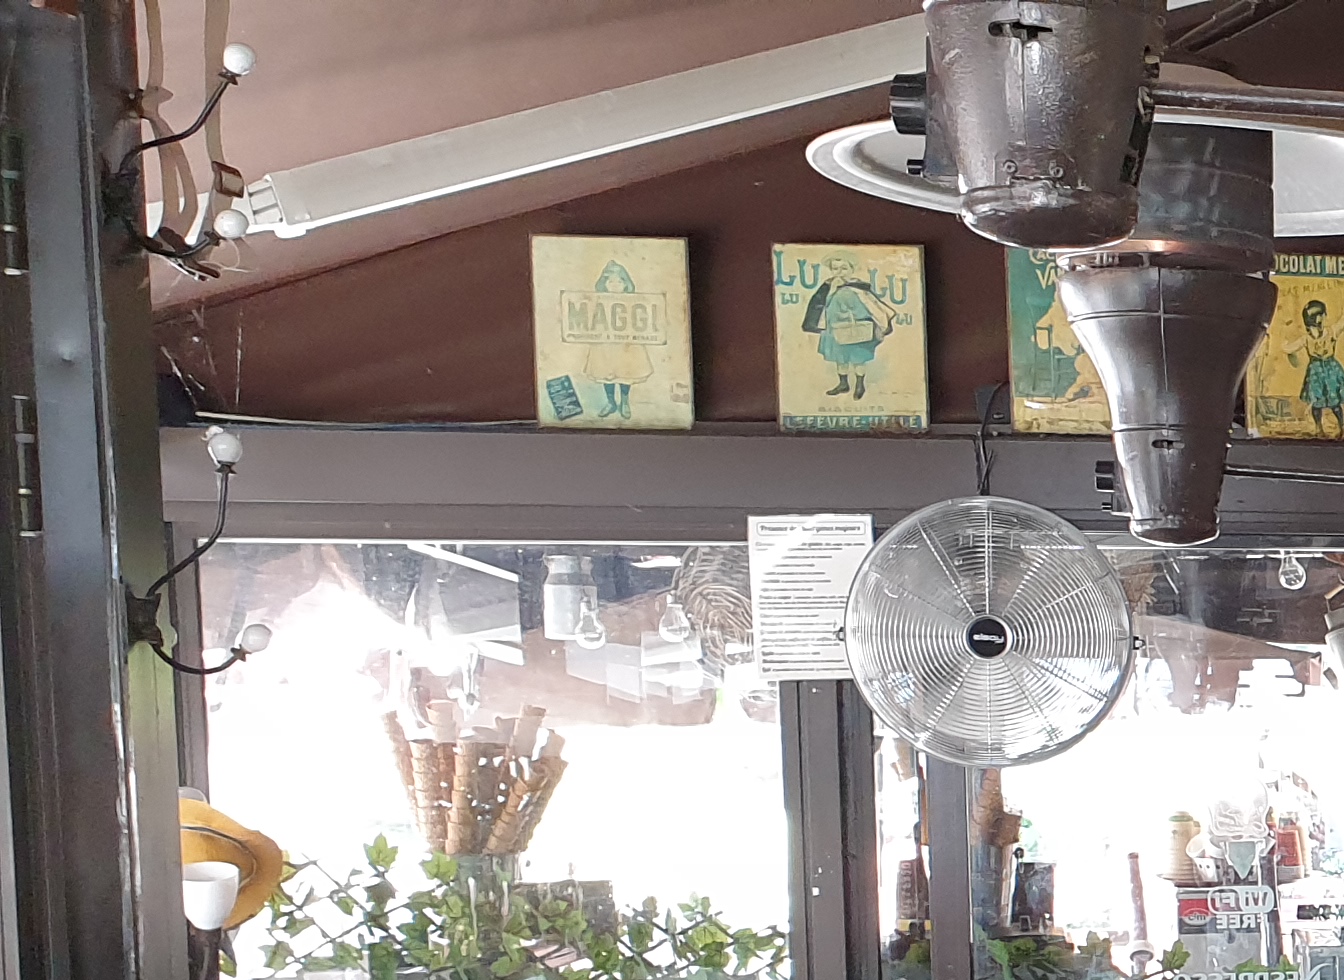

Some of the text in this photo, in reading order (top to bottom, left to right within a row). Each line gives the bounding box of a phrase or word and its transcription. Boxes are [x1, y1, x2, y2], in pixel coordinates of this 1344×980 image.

[774, 250, 909, 304] LU LU
[1275, 254, 1322, 274] COLAT
[568, 301, 658, 332] MAGGI
